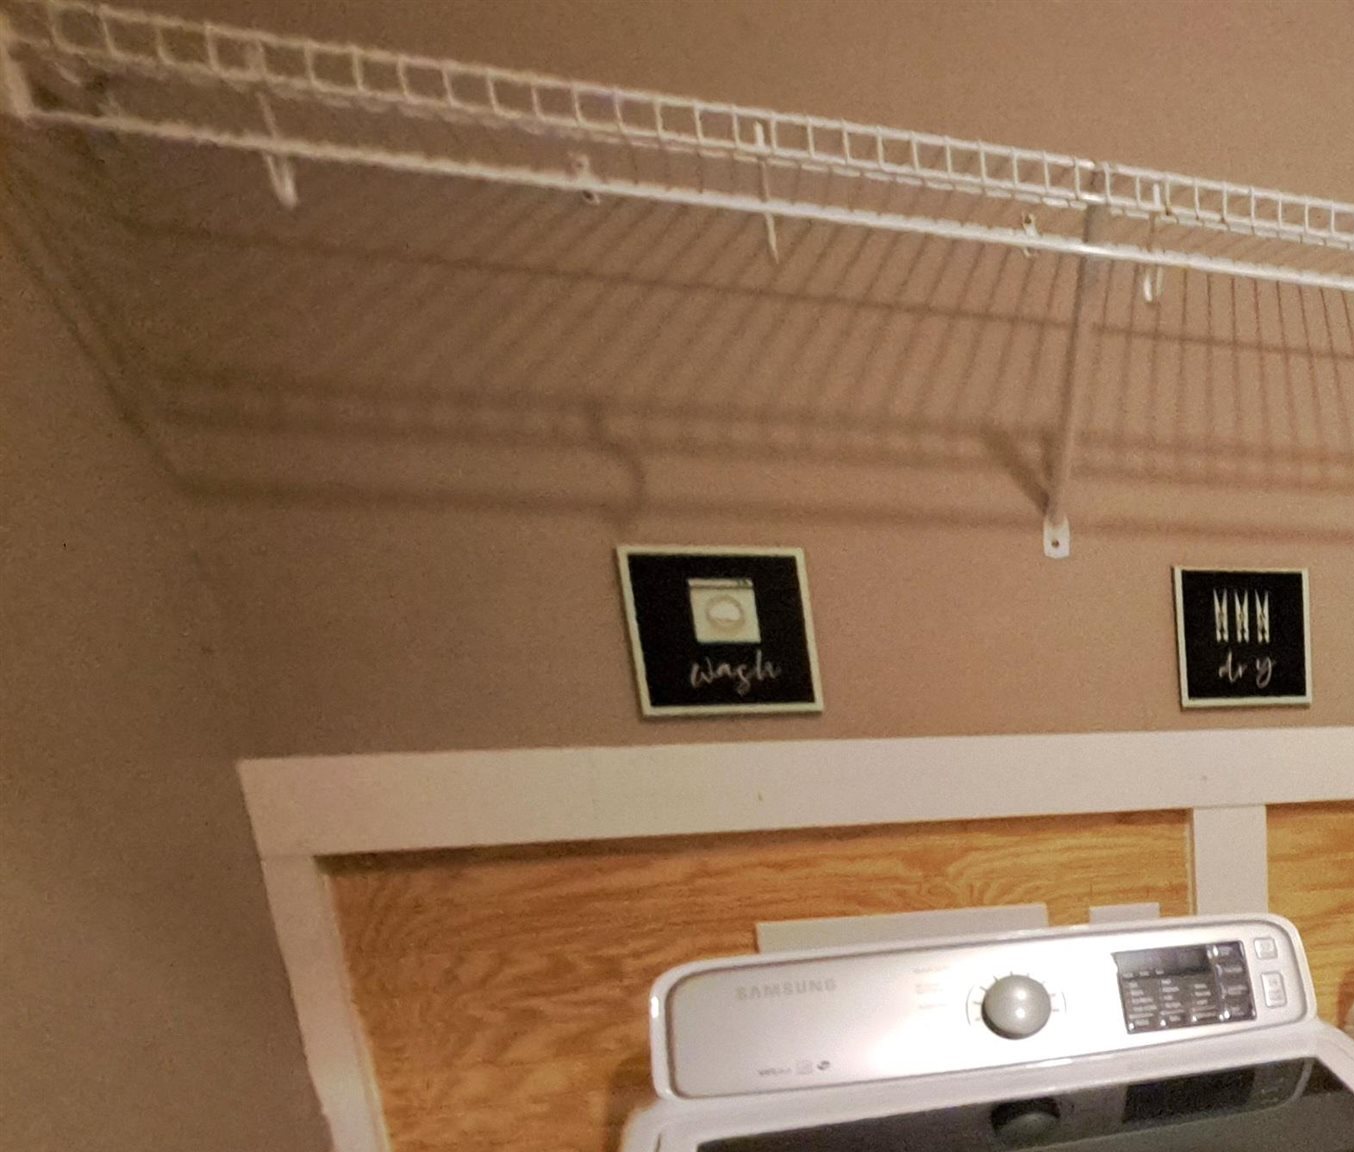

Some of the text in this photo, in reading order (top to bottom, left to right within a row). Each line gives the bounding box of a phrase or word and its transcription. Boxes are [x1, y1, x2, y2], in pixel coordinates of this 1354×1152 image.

[690, 650, 782, 696] wash
[1218, 649, 1275, 689] dry
[735, 978, 837, 1000] SAMSUNG
